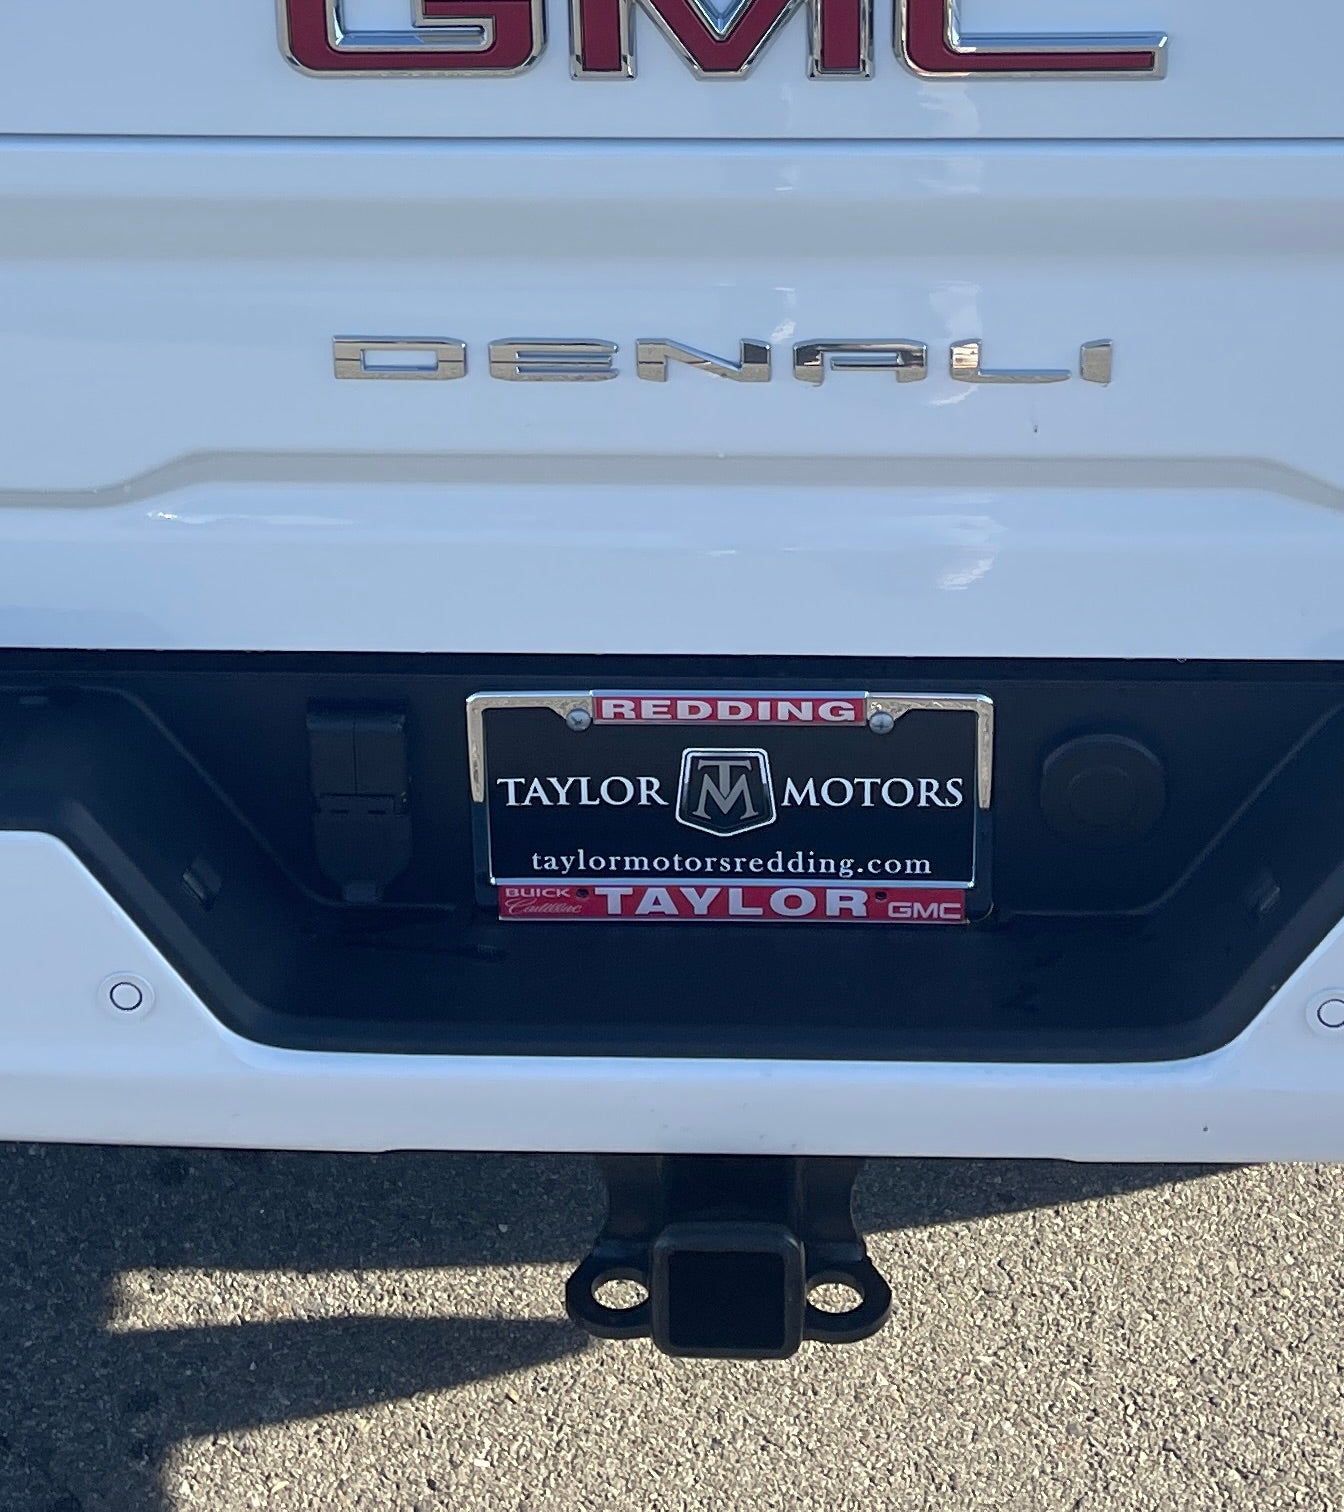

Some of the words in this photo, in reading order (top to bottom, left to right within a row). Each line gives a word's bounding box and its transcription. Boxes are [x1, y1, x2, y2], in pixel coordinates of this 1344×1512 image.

[333, 336, 1114, 386] DENALI
[601, 699, 856, 721] REDDING
[497, 776, 669, 807] TAYLOR
[781, 778, 964, 808] MOTORS
[532, 849, 932, 877] taylormotorsredding.com
[505, 888, 570, 898] BUICK
[594, 888, 868, 917] TAYLOR
[887, 901, 962, 920] GMC
